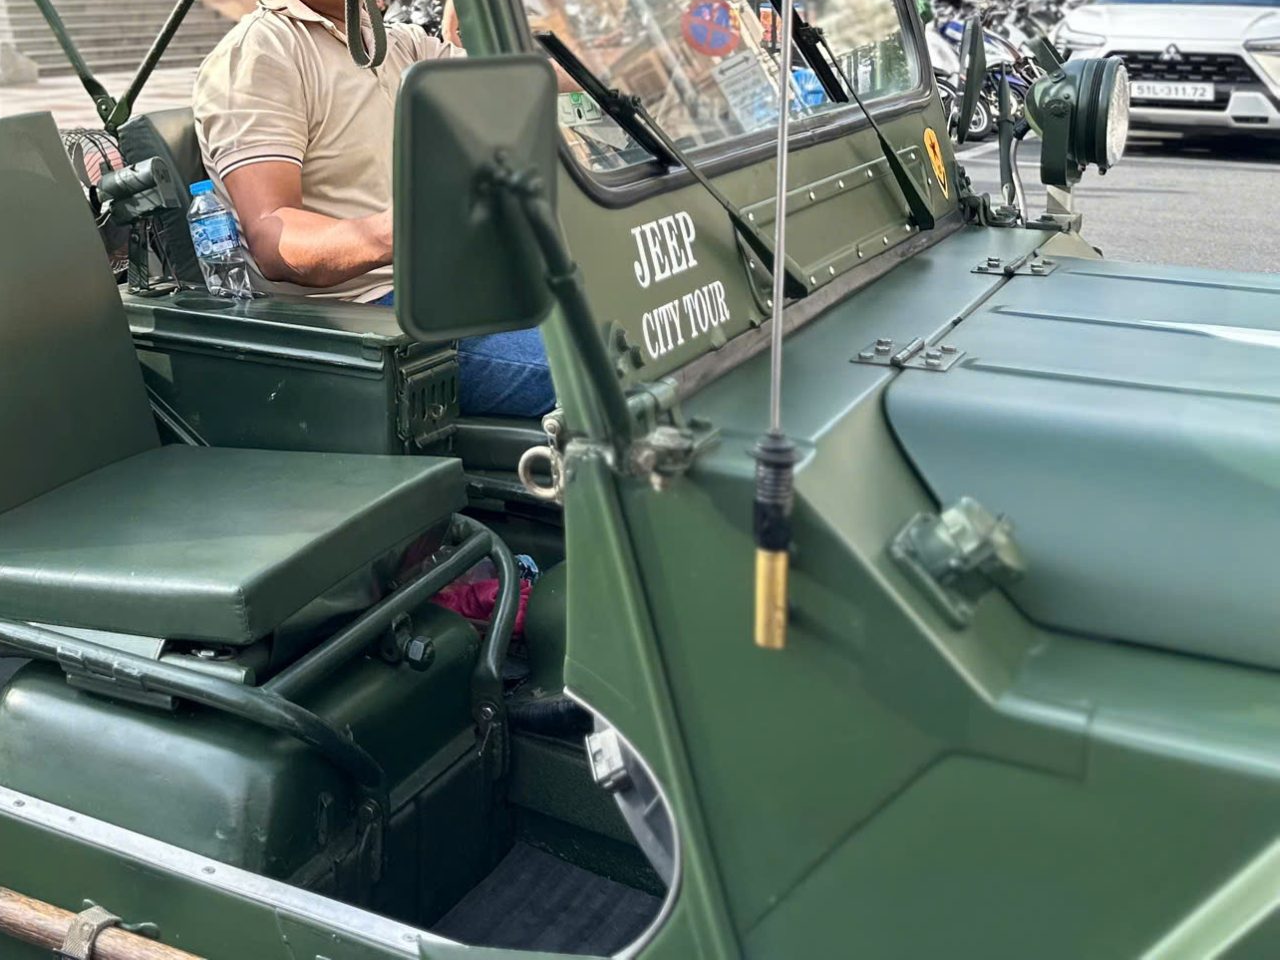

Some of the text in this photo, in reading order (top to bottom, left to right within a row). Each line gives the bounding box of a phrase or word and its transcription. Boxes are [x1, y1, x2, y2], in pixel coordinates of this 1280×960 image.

[1136, 84, 1207, 98] 51L-311.72
[630, 210, 699, 289] JEEP
[641, 279, 731, 360] CITY TOUR
